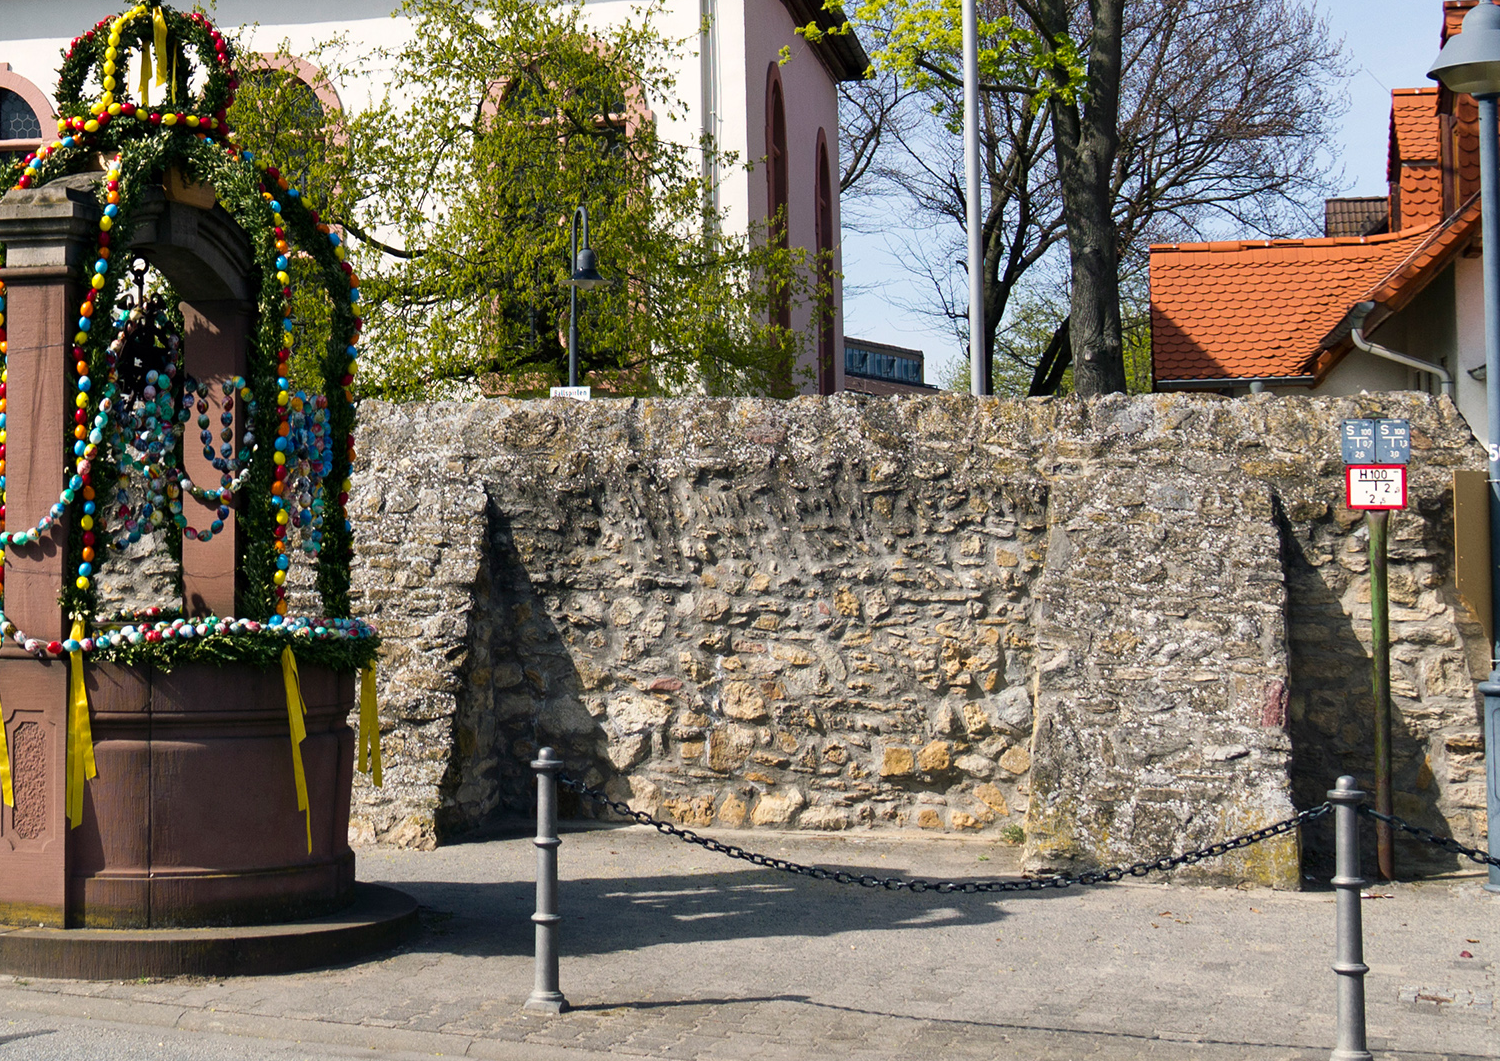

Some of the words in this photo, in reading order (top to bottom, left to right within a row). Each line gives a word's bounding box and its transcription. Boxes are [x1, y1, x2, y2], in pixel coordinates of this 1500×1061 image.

[1346, 425, 1355, 436] S
[1361, 428, 1372, 436] 100
[1381, 424, 1390, 435] S
[1489, 443, 1500, 461] 5
